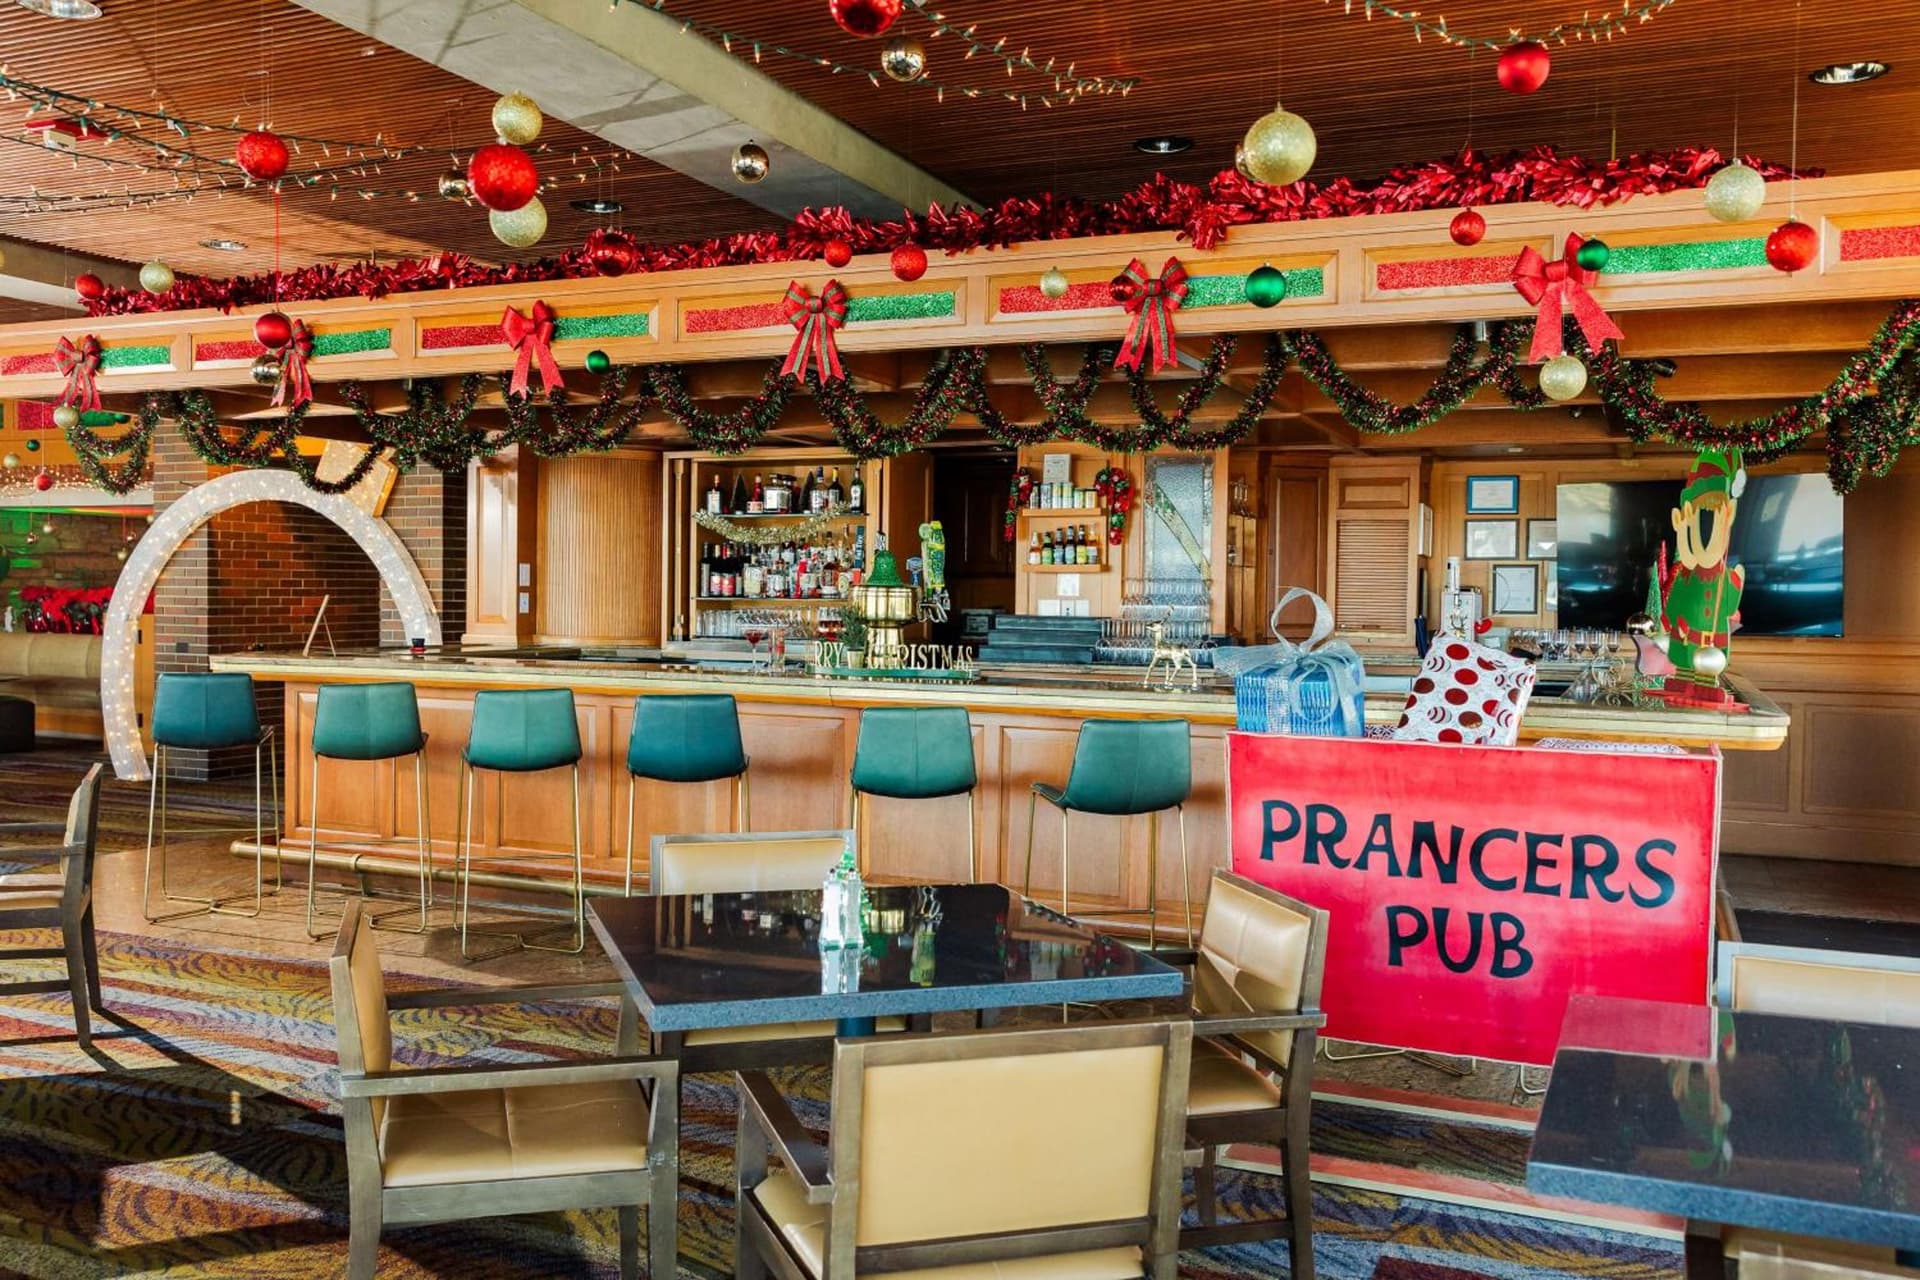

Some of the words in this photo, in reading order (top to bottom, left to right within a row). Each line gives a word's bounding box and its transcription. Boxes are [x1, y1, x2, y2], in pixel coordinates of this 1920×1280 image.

[809, 641, 844, 669] RRY
[1260, 799, 1677, 908] PRANCERS
[1386, 905, 1534, 978] PUB
